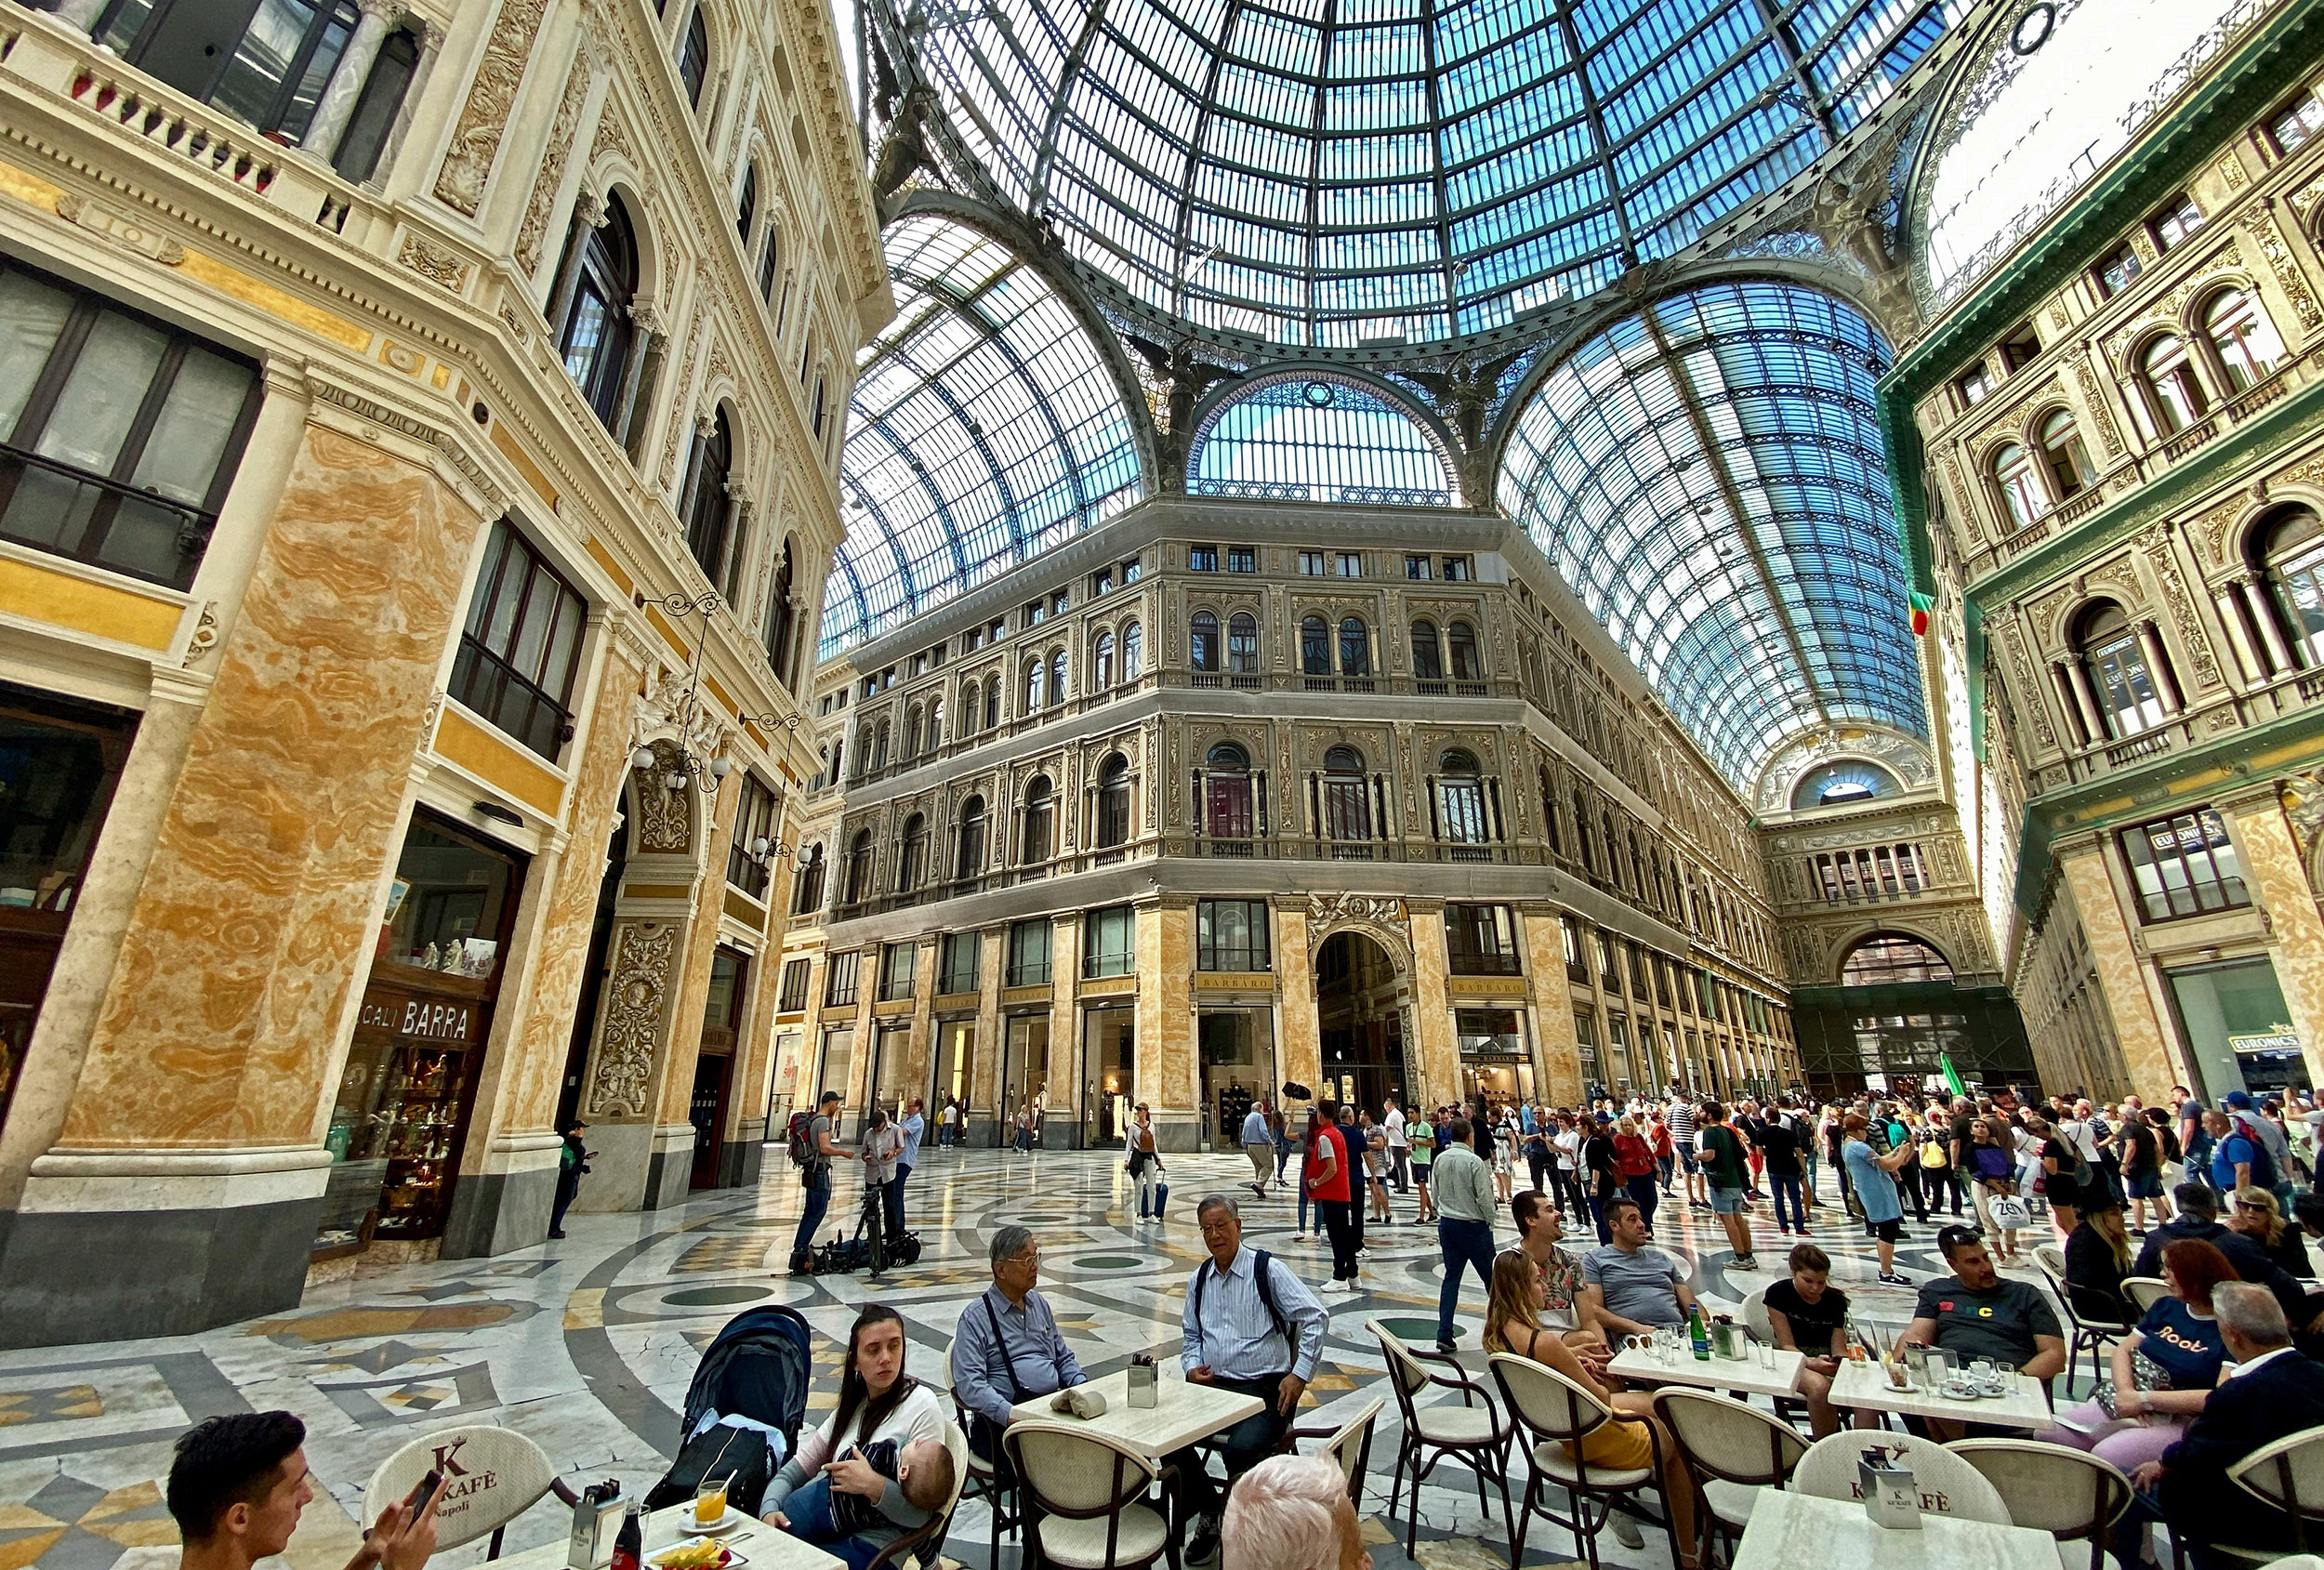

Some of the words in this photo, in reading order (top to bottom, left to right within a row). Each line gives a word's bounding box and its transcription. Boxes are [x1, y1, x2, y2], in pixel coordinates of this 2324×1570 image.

[1204, 980, 1267, 988] BARBARO
[1459, 984, 1521, 993] BARBARO
[363, 1005, 398, 1027] CALI
[402, 1001, 468, 1039] BARRA
[2233, 1036, 2299, 1049] EURONICS
[431, 1442, 469, 1476] K
[440, 1470, 497, 1501] KAFÈ
[434, 1500, 470, 1518] Napoli
